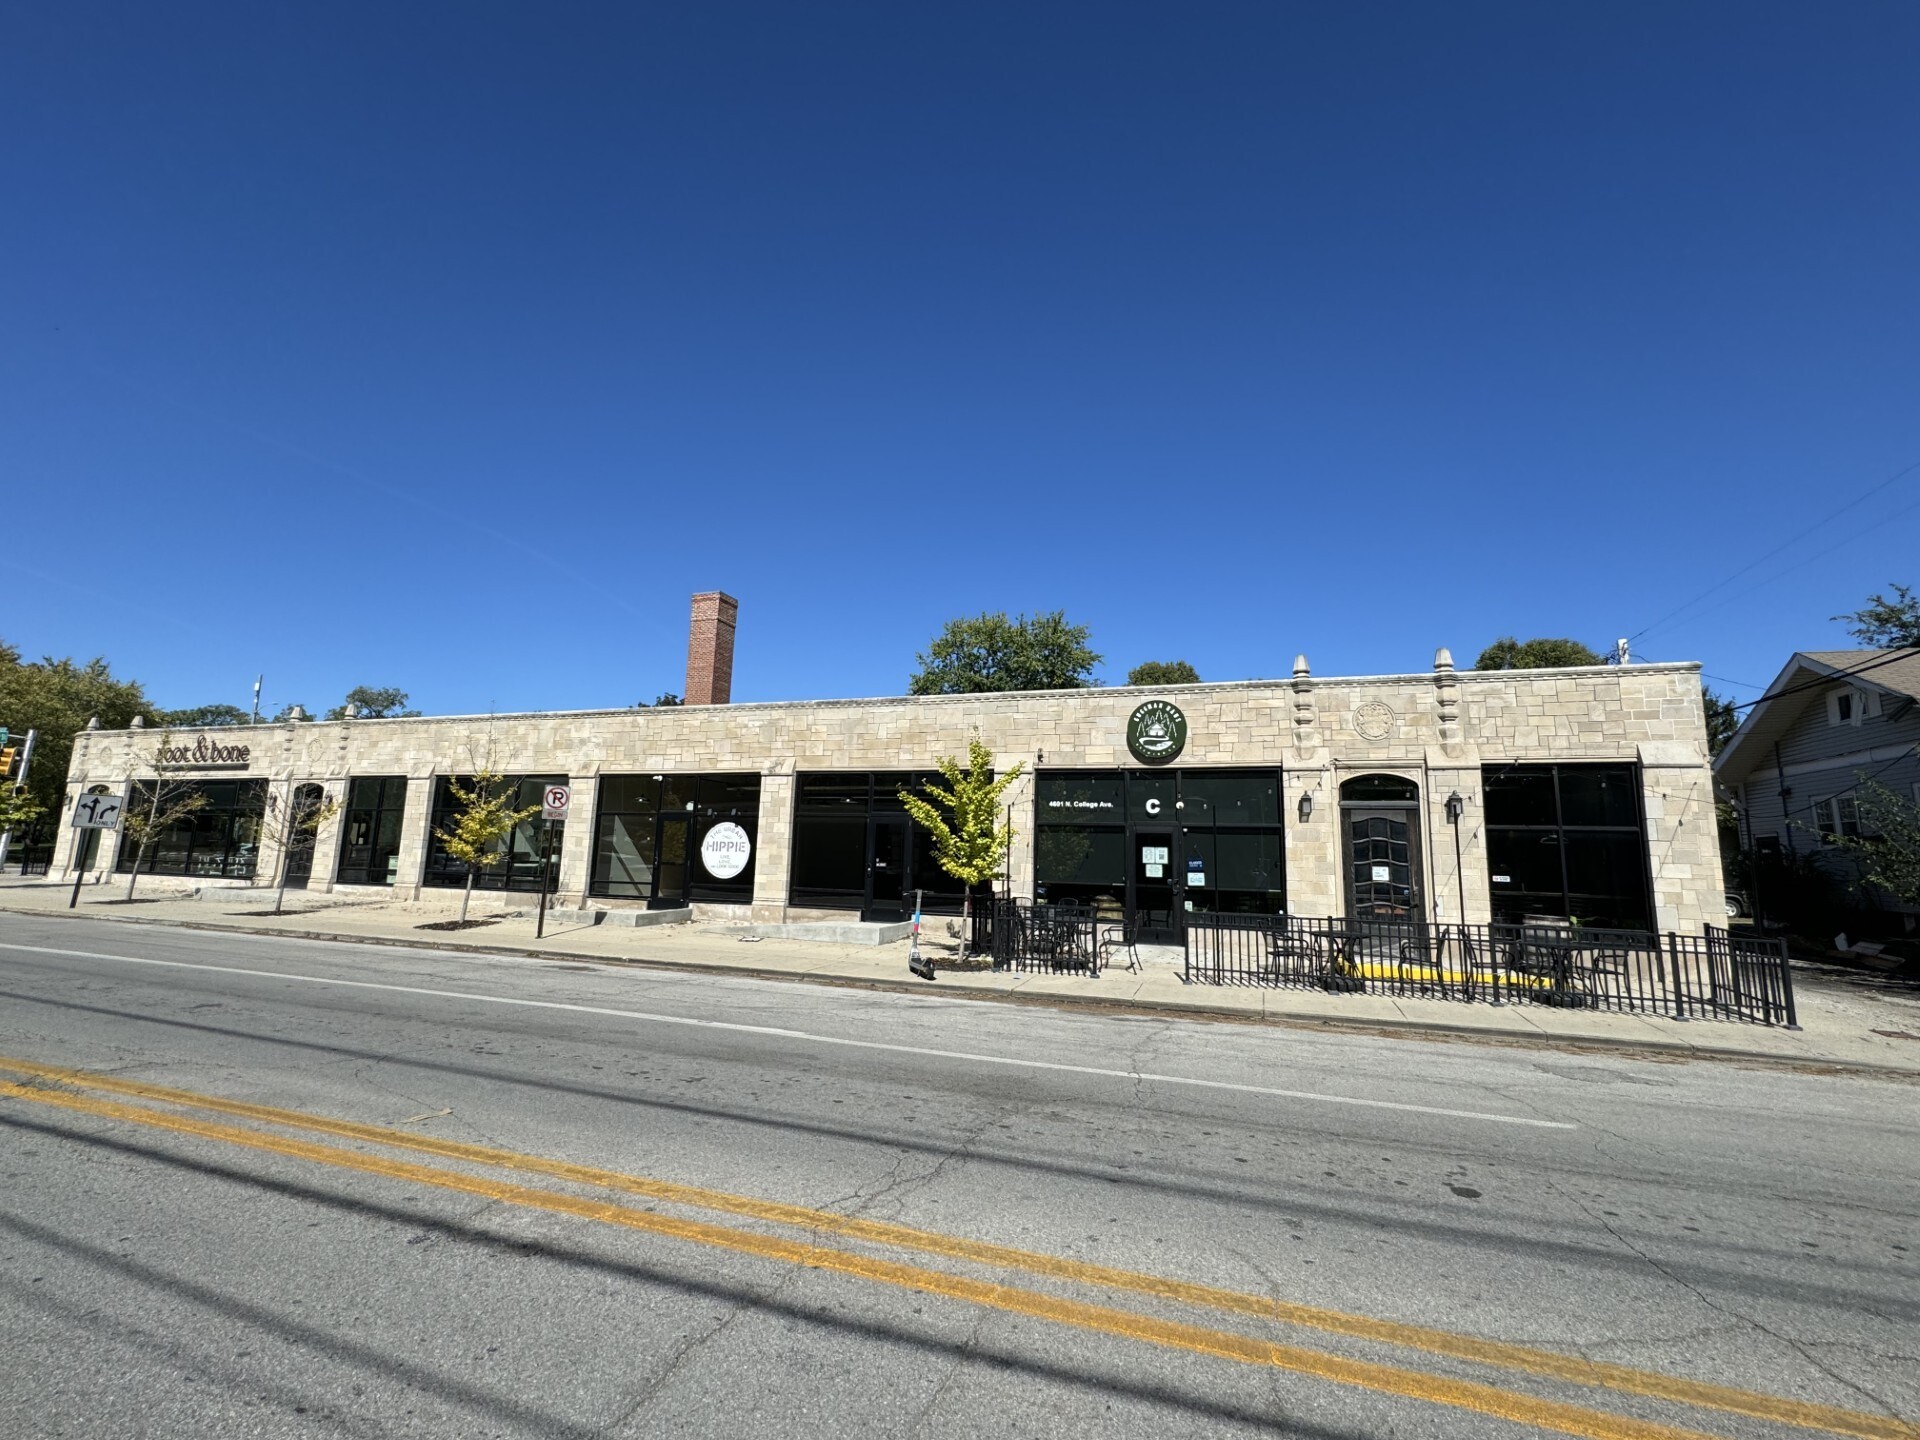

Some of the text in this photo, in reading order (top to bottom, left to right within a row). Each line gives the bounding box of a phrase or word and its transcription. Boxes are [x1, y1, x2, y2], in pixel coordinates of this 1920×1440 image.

[192, 734, 209, 762] &
[210, 740, 250, 762] bone
[1073, 801, 1098, 809] College
[1145, 798, 1160, 814] C
[710, 828, 722, 840] THE
[706, 841, 746, 853] HIPPIE
